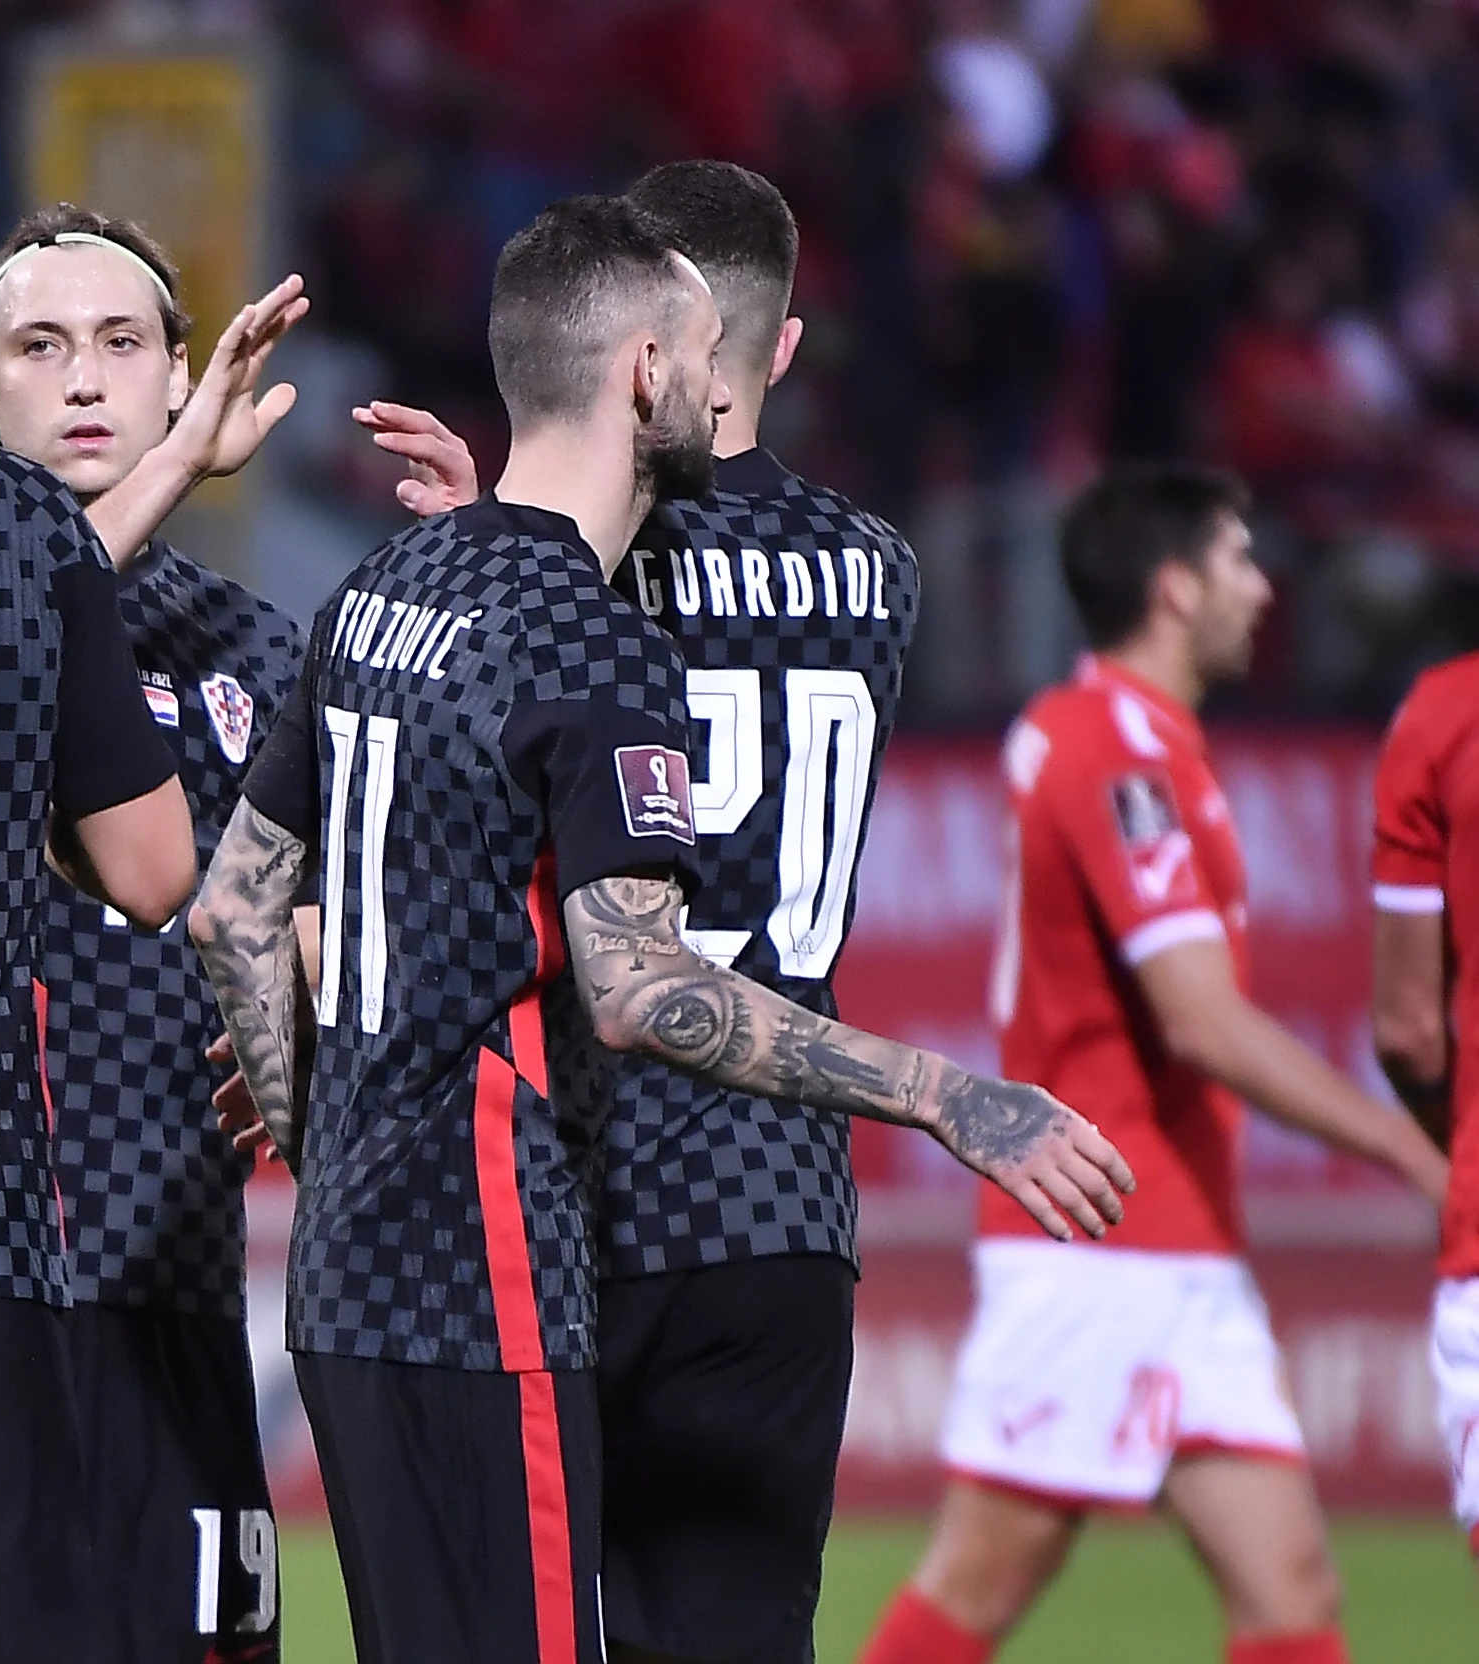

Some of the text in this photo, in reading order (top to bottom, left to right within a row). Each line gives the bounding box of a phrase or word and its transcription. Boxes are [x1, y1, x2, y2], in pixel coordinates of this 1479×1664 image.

[318, 704, 400, 1035] 11
[678, 668, 877, 979] 20
[192, 1508, 277, 1635] 19
